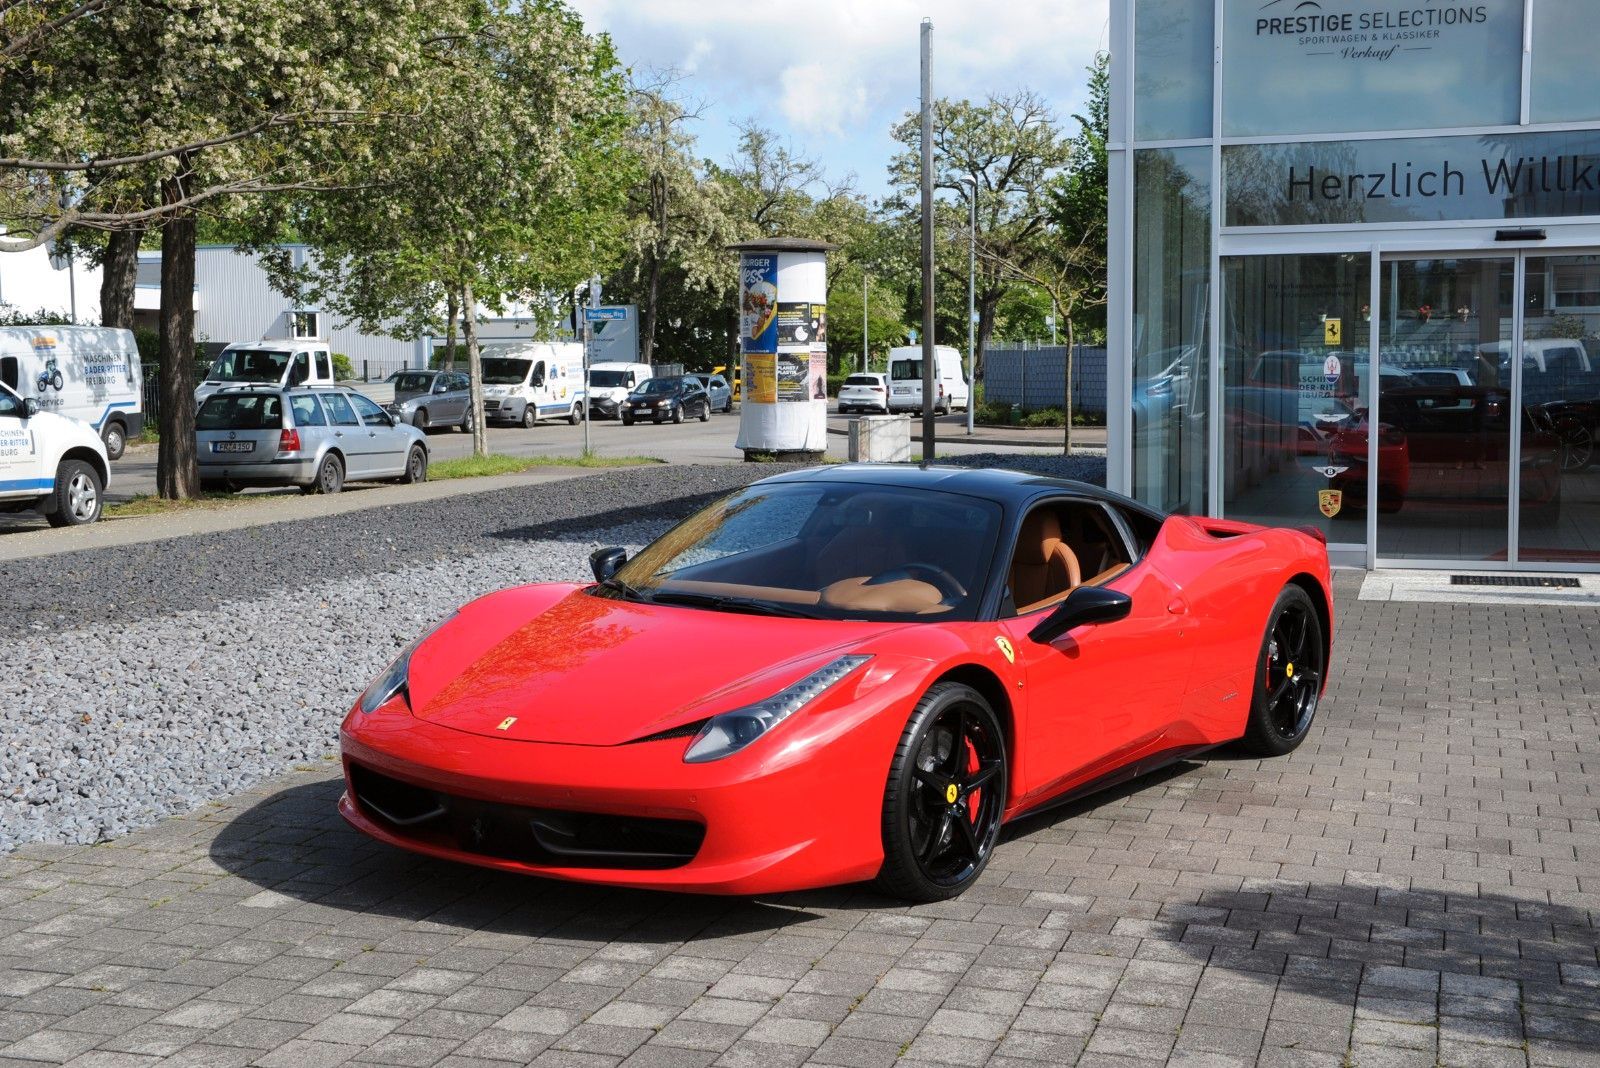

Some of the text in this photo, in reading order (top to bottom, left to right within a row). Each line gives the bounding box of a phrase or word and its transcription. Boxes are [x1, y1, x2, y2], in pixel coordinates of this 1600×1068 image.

[1256, 6, 1488, 36] PRESTIGE SELECTIONS
[1298, 34, 1367, 46] SPORTWAGEN
[1382, 30, 1440, 41] KLASSIKER
[1341, 45, 1400, 61] Verkauf
[1288, 155, 1600, 201] Herzlich Willk
[83, 354, 122, 363] MASCHINEN
[86, 376, 116, 386] FREIBURG
